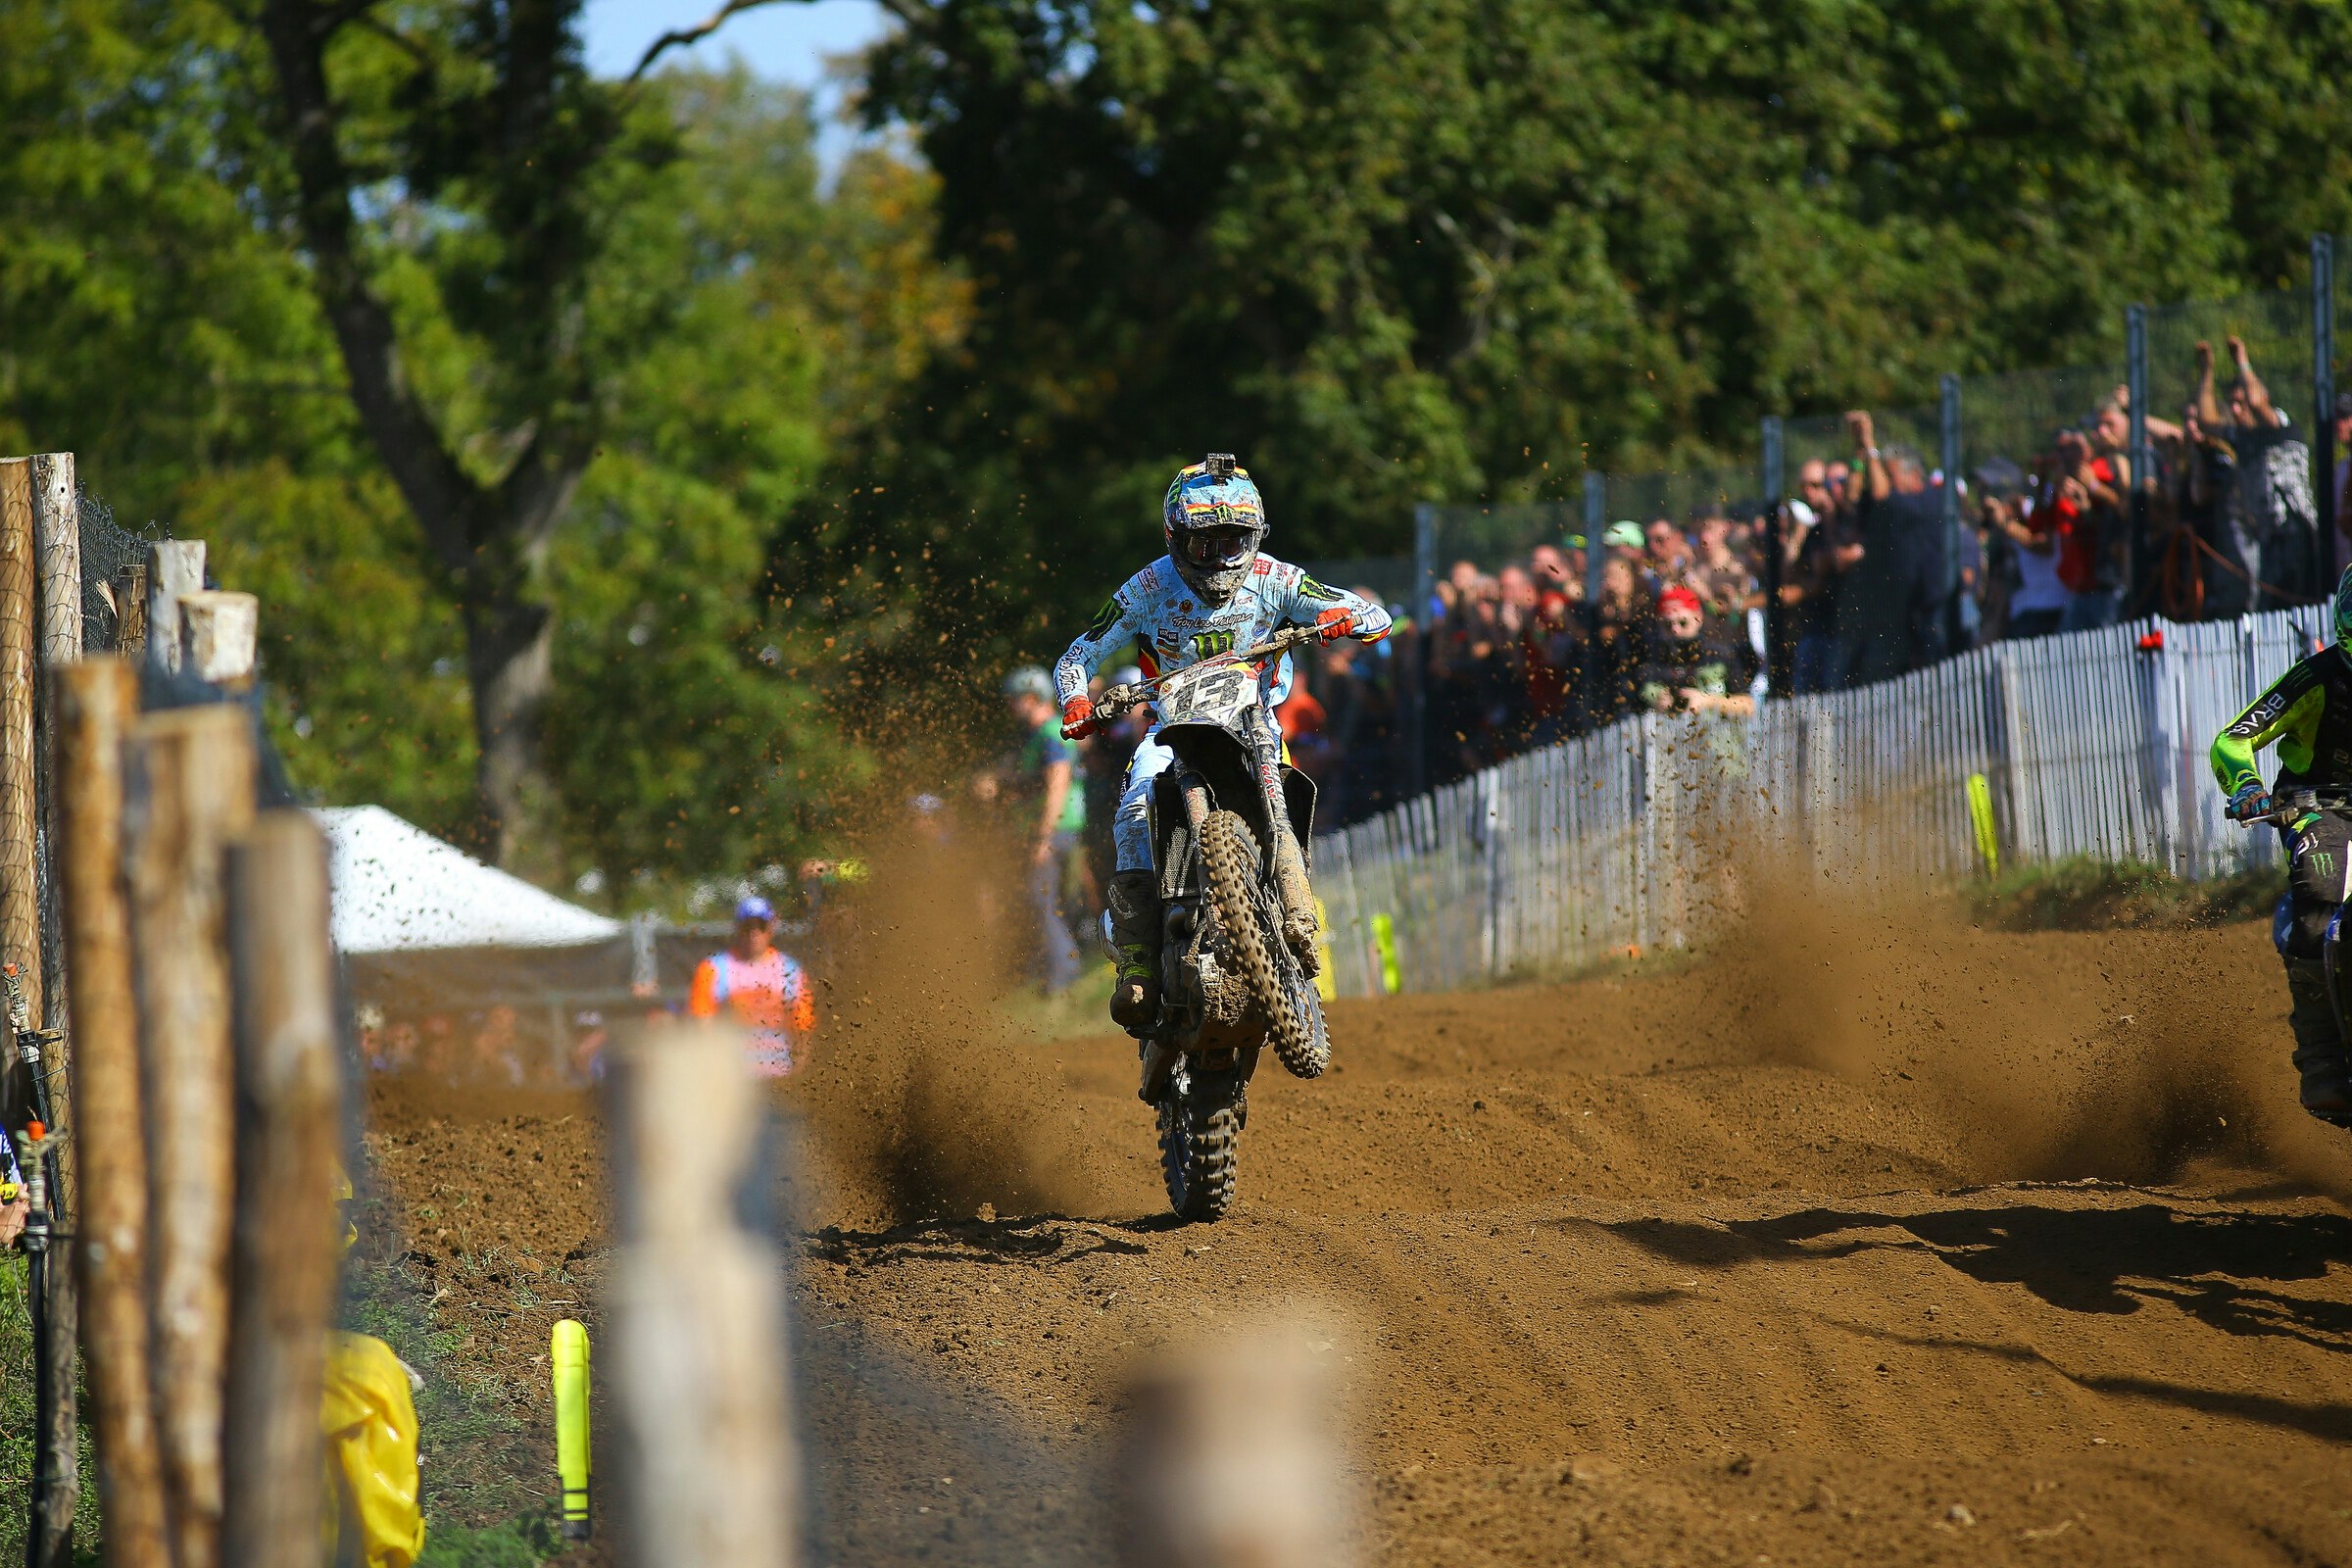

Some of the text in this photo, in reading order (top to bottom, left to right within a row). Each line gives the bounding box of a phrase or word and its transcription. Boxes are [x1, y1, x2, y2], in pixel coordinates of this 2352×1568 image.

[1172, 612, 1254, 629] Troy Lee Designs
[1174, 669, 1245, 716] 13
